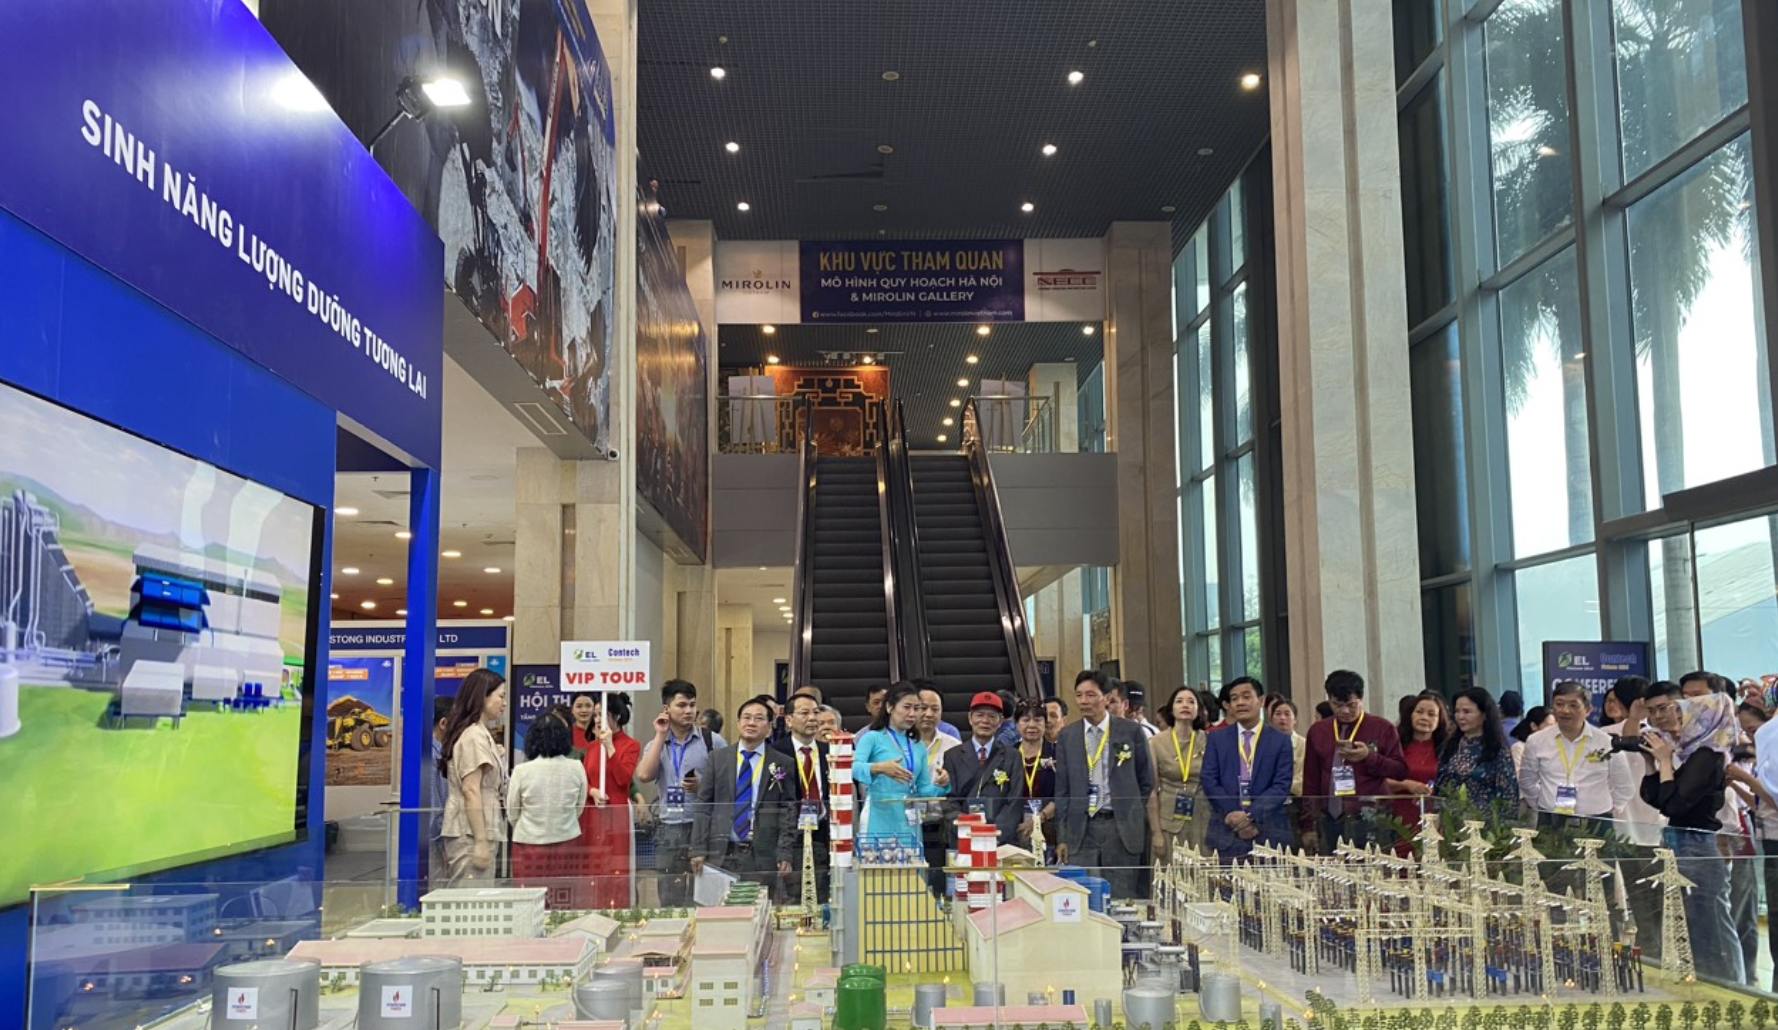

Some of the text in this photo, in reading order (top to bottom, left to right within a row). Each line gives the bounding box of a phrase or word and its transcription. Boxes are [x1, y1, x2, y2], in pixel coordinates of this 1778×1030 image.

[80, 99, 427, 400] SINH NĂNG LƯỢNG DƯỠNG TƯƠNG LAI
[820, 250, 1004, 275] KHU VỰC THAM QUAN
[721, 280, 791, 290] MIROLIN
[821, 275, 1003, 290] MÔ HÌNH QUY HOẠCH HÀ NỘI
[850, 291, 975, 302] & MIROLIN GALLERY
[439, 634, 458, 643] LTD
[585, 651, 598, 659] EL
[608, 648, 640, 657] Contech
[1573, 655, 1590, 666] EL
[536, 676, 551, 684] EL
[565, 671, 646, 685] VIP TOUR
[520, 691, 548, 711] HỘI
